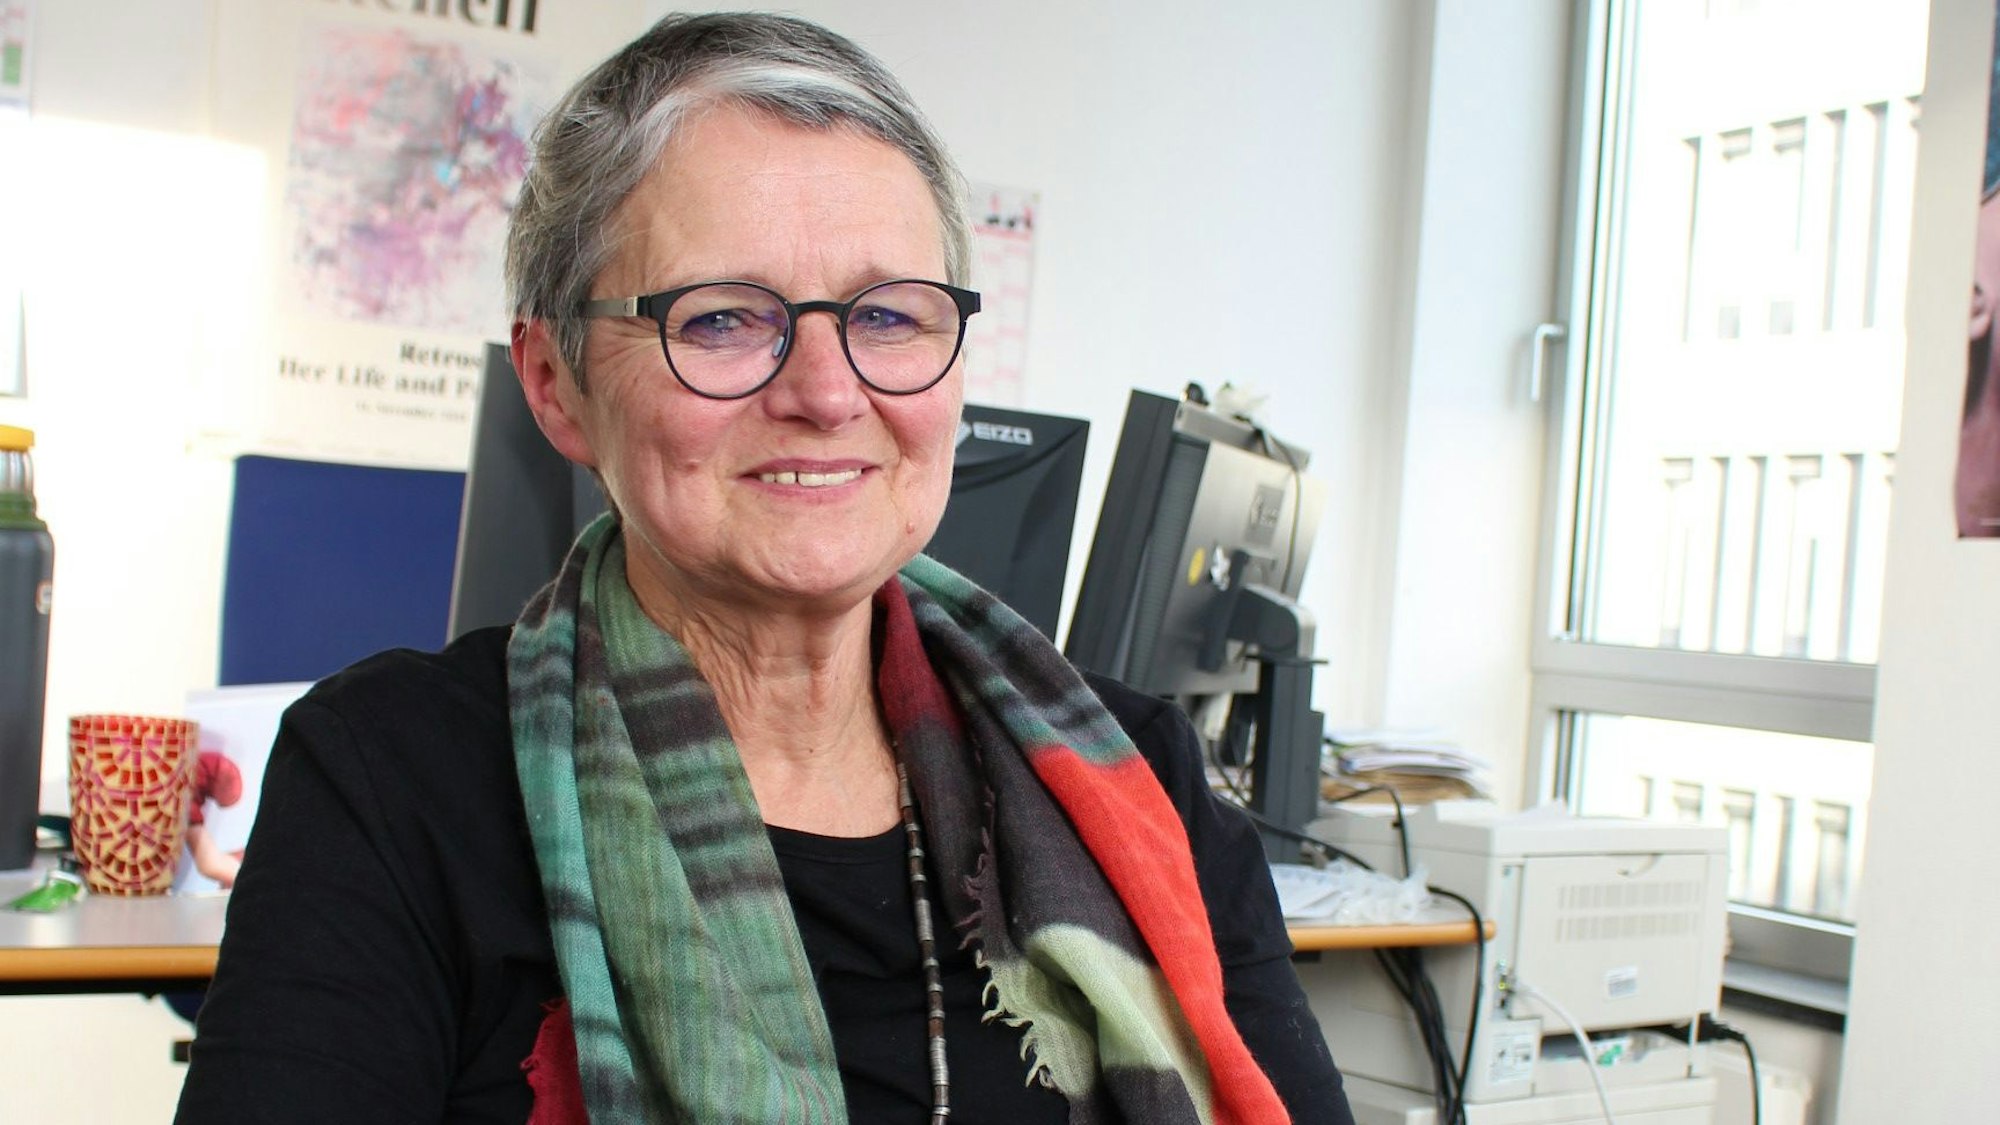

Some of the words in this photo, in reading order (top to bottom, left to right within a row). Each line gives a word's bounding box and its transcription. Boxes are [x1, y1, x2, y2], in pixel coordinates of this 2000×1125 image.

[279, 357, 327, 380] Her
[338, 365, 386, 388] Life
[395, 374, 446, 395] and
[973, 421, 1033, 446] EIZO
